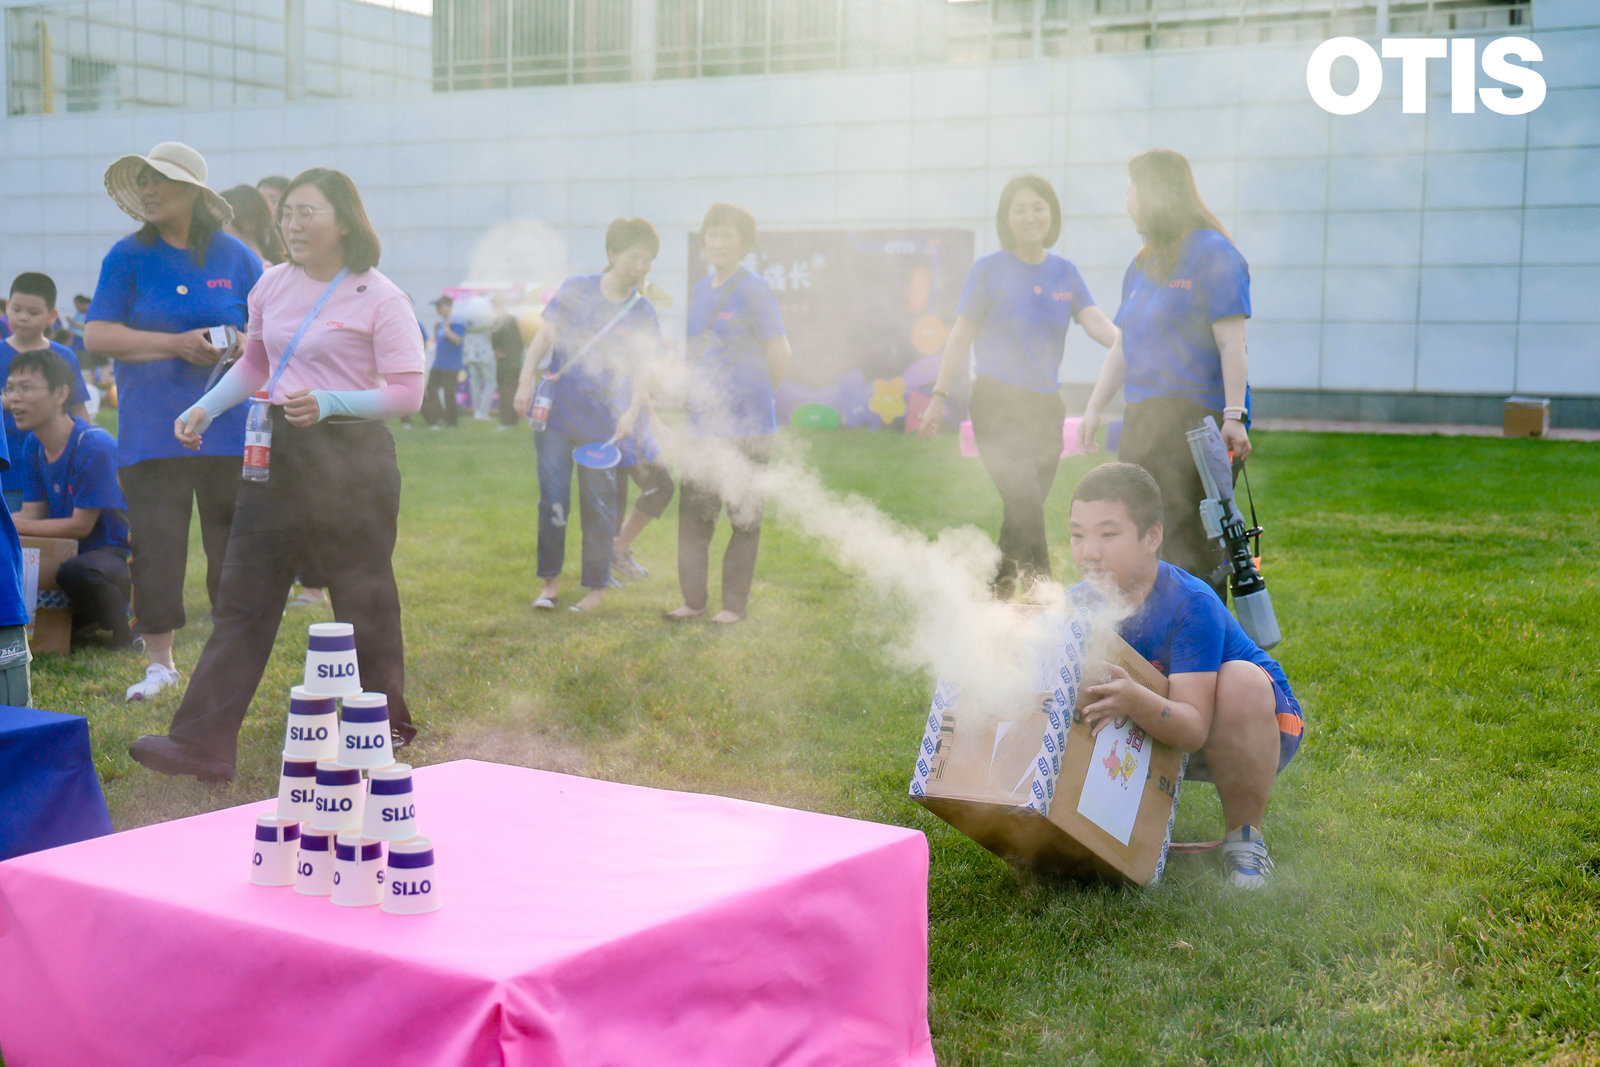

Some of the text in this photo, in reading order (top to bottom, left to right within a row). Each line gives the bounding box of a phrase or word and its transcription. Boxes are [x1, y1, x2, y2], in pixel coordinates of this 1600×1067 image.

[317, 662, 355, 678] OTIS
[928, 715, 939, 733] OTIS
[1048, 711, 1060, 730] OTIS
[290, 726, 329, 741] OTIS
[345, 734, 385, 749] OTIS
[923, 738, 934, 755] OTIS
[1043, 734, 1055, 753] OTIS
[917, 760, 928, 777] OTIS
[1037, 757, 1049, 777] OTIS
[290, 789, 315, 803] TIS
[1032, 781, 1044, 800] OTIS
[315, 797, 353, 812] OTIS
[381, 804, 416, 822] OTIS
[391, 879, 431, 896] OTIS
